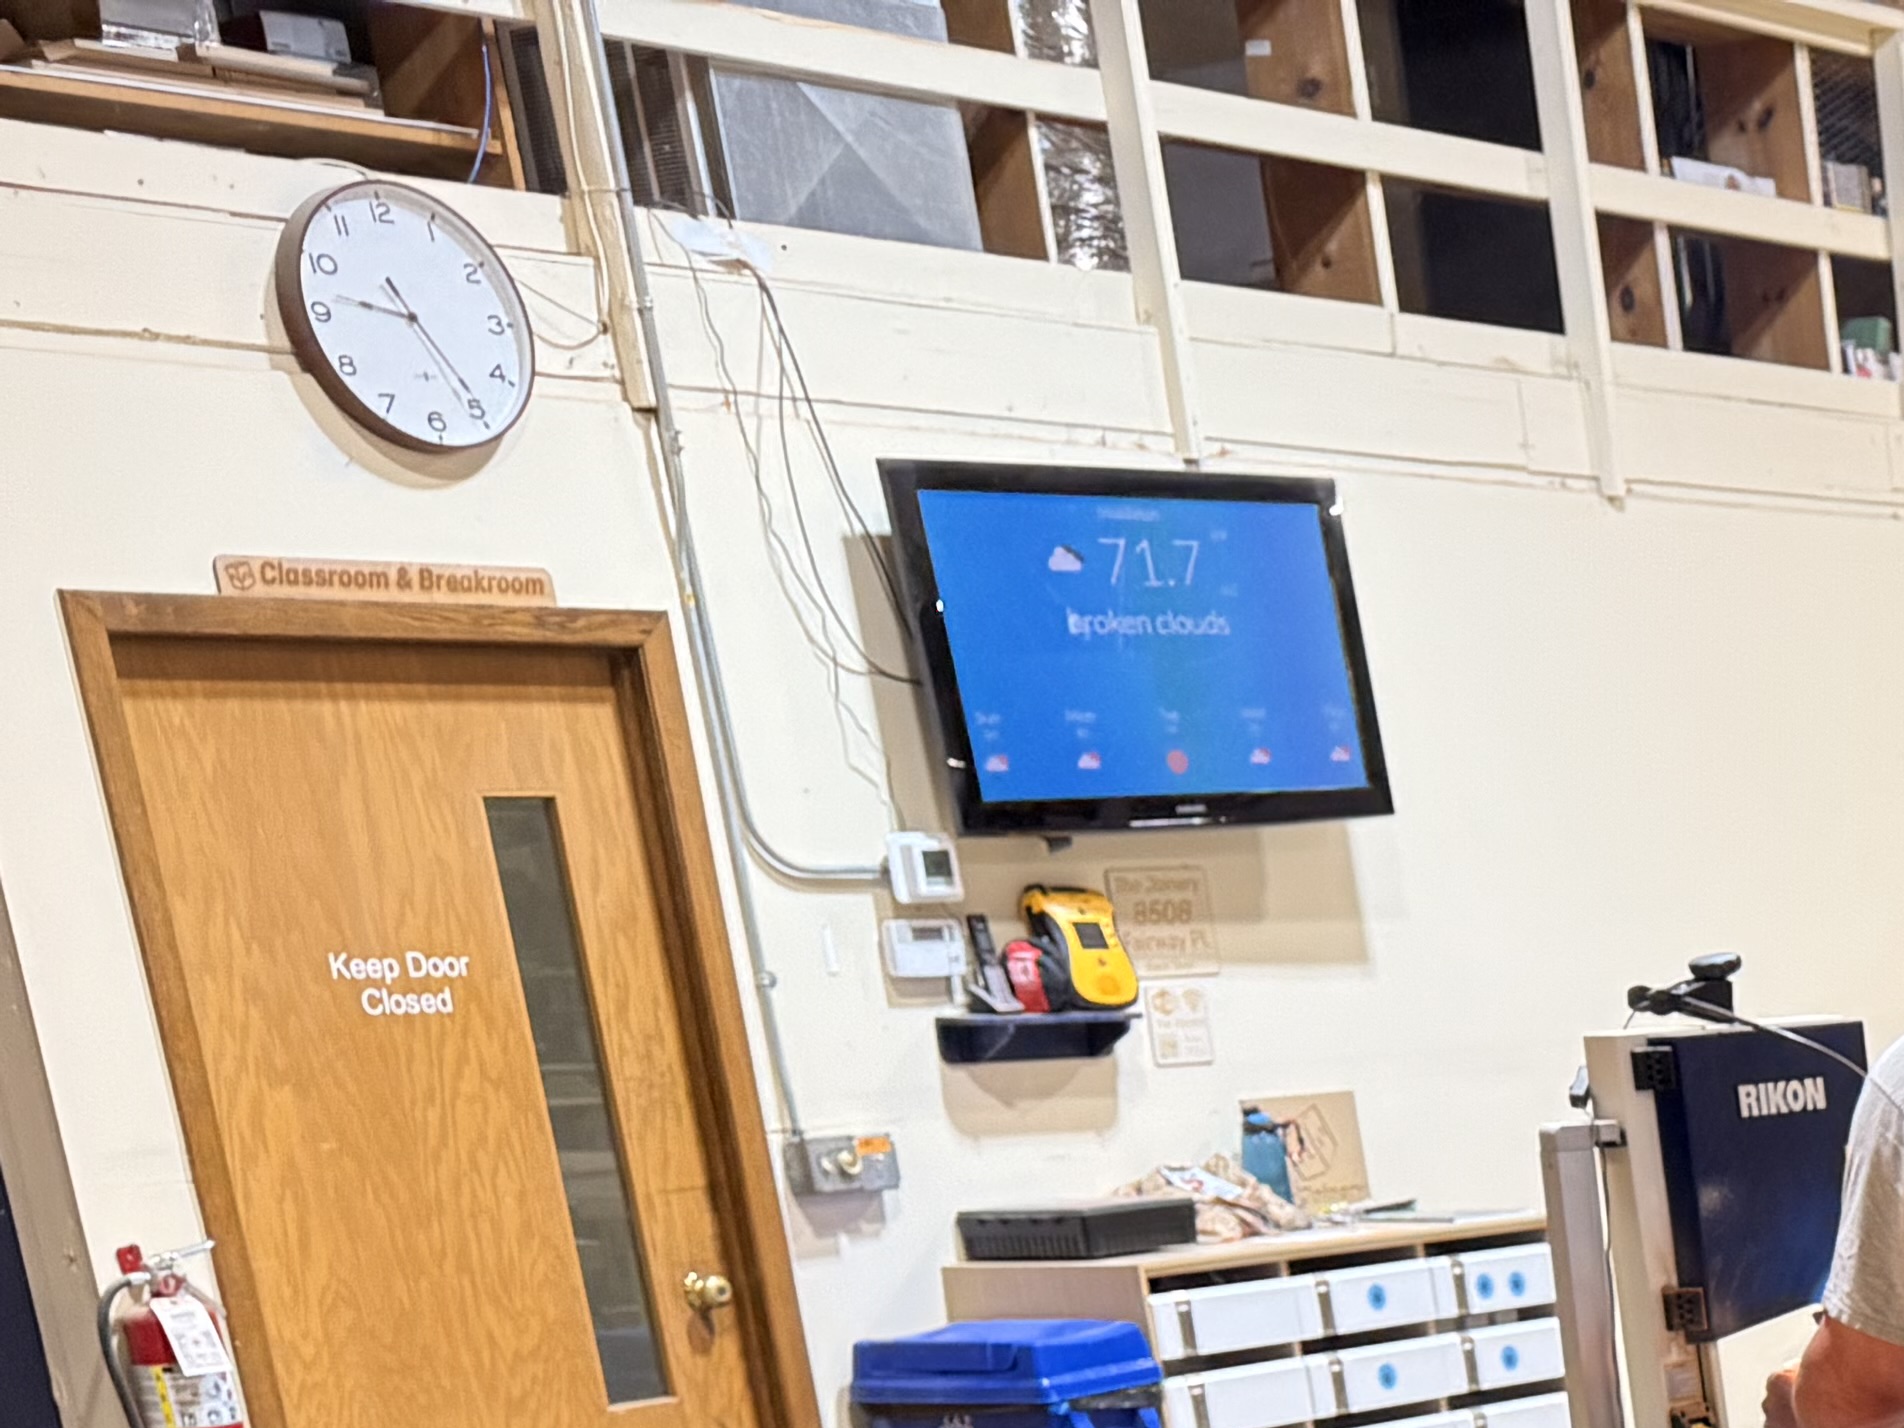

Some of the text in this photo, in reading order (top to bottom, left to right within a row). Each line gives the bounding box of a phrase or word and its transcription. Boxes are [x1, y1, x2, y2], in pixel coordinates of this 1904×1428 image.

[369, 201, 395, 225] 12
[334, 214, 350, 237] 11
[309, 253, 339, 276] 10
[463, 263, 482, 284] 2
[310, 301, 332, 323] 9
[487, 315, 505, 336] 3
[338, 354, 357, 377] 8
[489, 363, 506, 383] 4
[378, 393, 395, 414] 7
[468, 398, 486, 420] 5
[427, 411, 447, 432] 6
[1096, 536, 1200, 588] 71.7
[260, 561, 545, 596] Classroom & Breakroom
[1155, 609, 1231, 636] clouds
[1134, 899, 1192, 926] 8508
[327, 950, 470, 985] Keep Door
[361, 986, 454, 1016] Closed
[1737, 1076, 1827, 1119] RIKON
